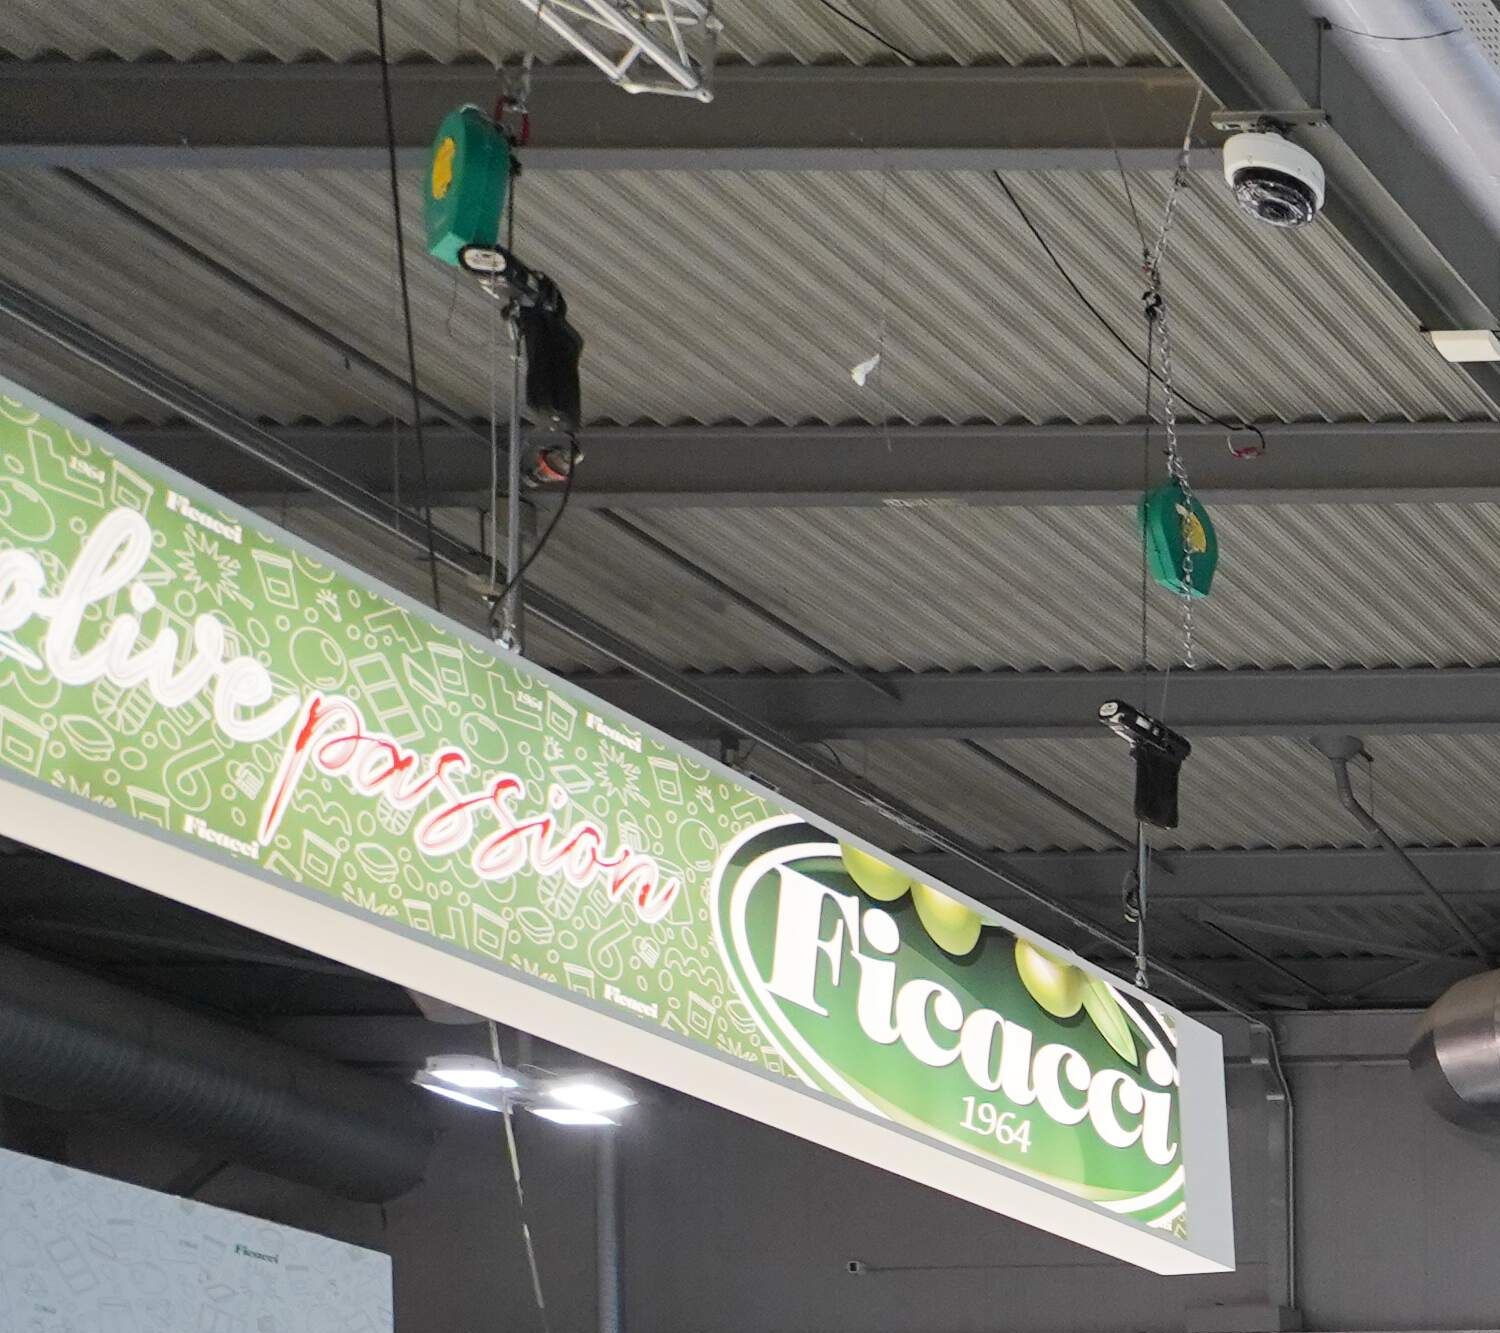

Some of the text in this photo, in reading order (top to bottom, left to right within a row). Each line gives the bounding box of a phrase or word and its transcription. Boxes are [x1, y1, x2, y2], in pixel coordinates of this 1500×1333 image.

[259, 690, 682, 922] passion
[768, 860, 1181, 1166] Ficacci
[959, 1092, 1032, 1156] 1964
